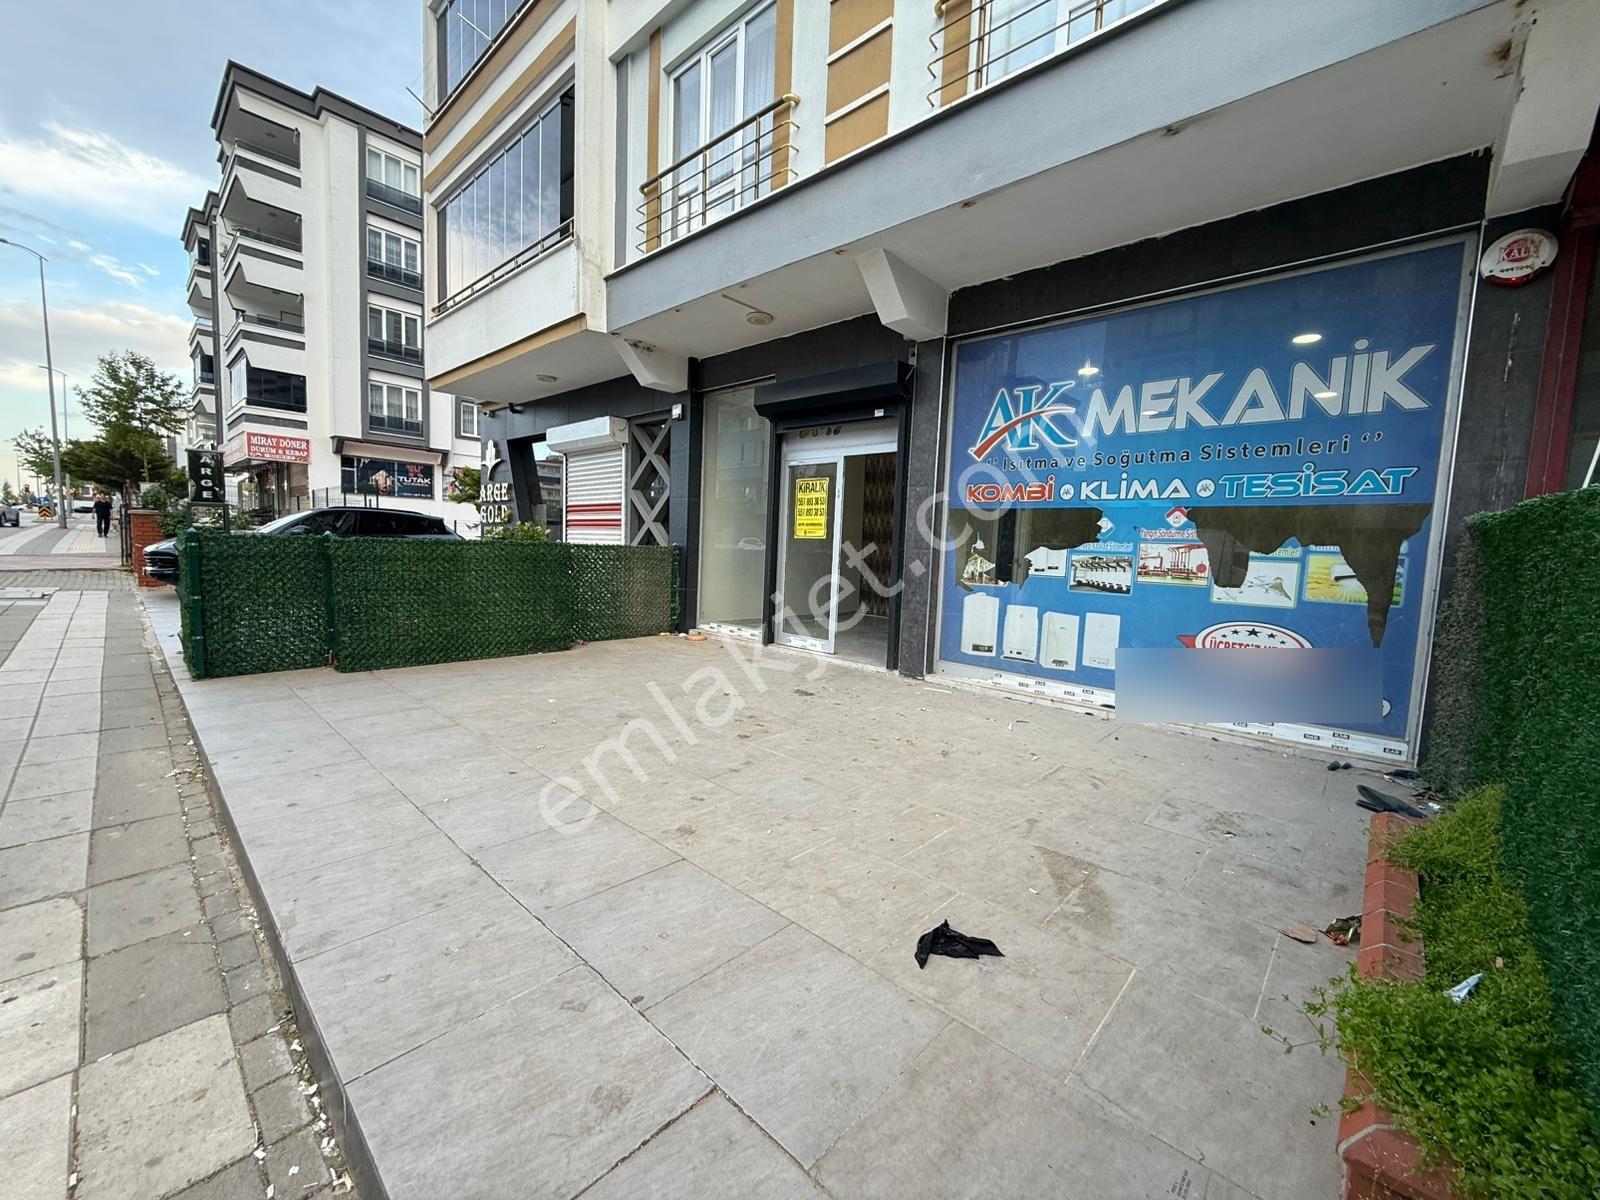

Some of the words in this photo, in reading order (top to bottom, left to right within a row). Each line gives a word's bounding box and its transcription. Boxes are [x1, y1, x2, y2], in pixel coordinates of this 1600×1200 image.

[968, 381, 1078, 462] AK
[1080, 338, 1438, 439] MEKANİK
[1002, 456, 1059, 471] Isıtma
[1066, 456, 1086, 469] ve
[1093, 449, 1191, 468] Soğutma
[1200, 434, 1351, 460] Sistemleri
[200, 456, 213, 499] ARGE
[398, 475, 431, 484] TUTAK
[480, 482, 509, 503] ARGE
[966, 474, 1055, 503] KOMBİ
[1080, 472, 1191, 500] KLİMA
[1218, 462, 1419, 499] TESİSAT
